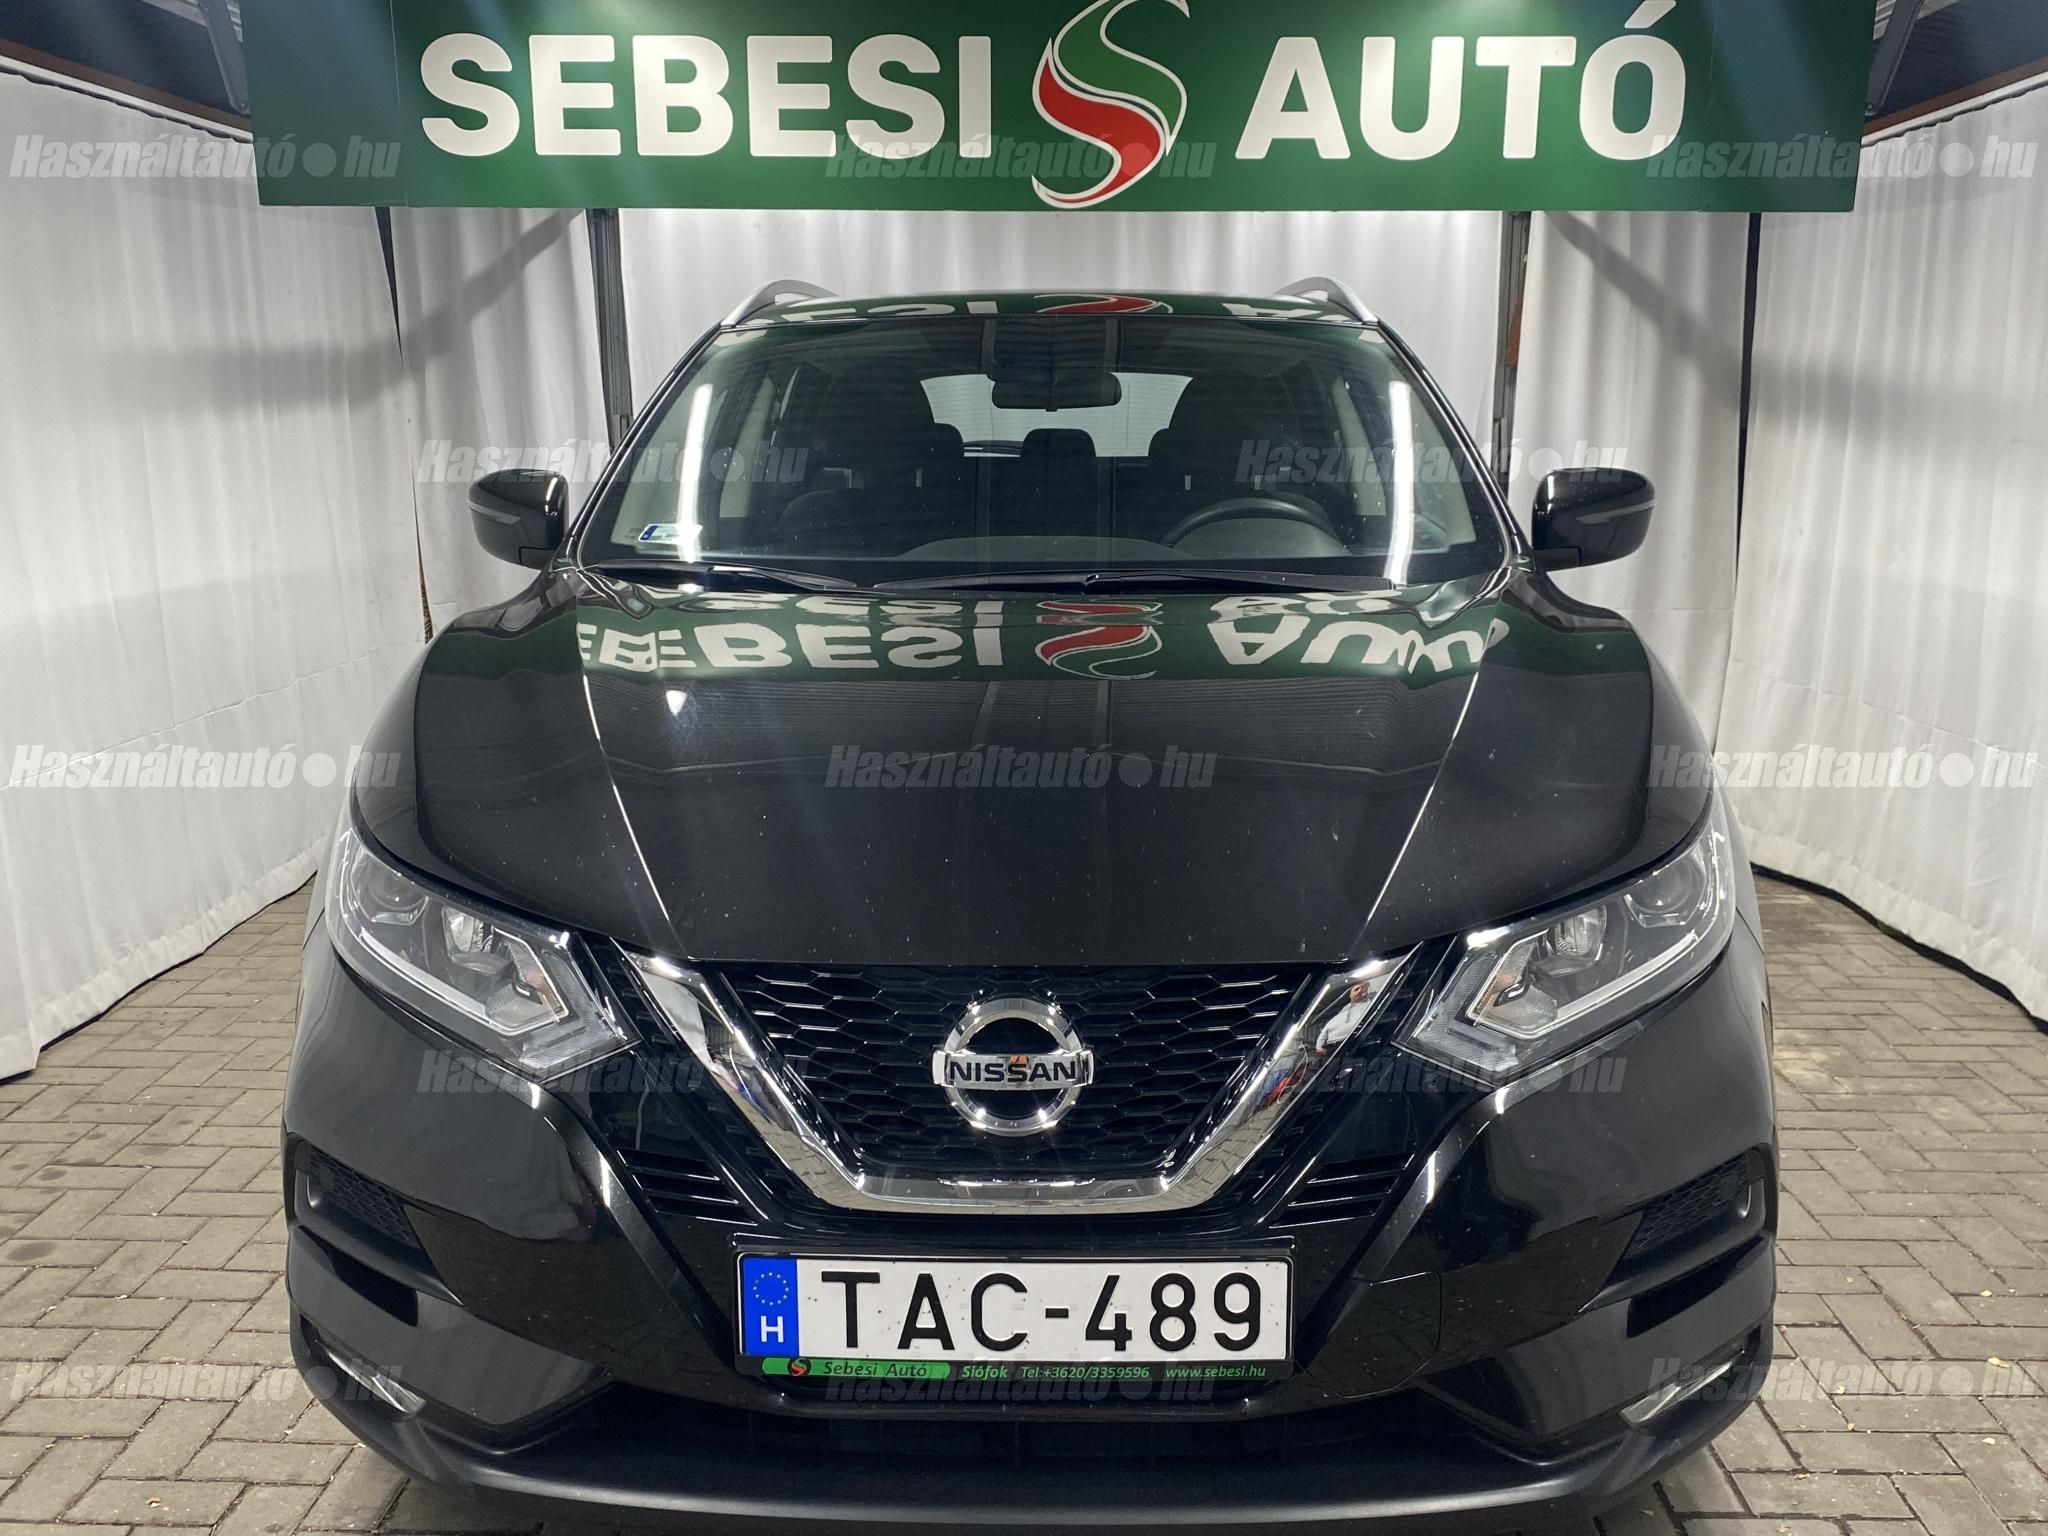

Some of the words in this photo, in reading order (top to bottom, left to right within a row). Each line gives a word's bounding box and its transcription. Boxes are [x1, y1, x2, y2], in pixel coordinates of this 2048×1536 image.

[421, 33, 992, 158] SEBESI
[1235, 0, 1686, 160] AUTÓ
[949, 1061, 1077, 1083] NISSAN
[820, 1271, 1262, 1352] TAC-489
[761, 1316, 784, 1342] H
[823, 1361, 878, 1377] Sebesi
[885, 1361, 928, 1378] Autó
[961, 1364, 1009, 1380] Siófok
[1021, 1365, 1150, 1379] Tel:+3620/3359596
[1165, 1364, 1266, 1378] www.sebesi.hu
